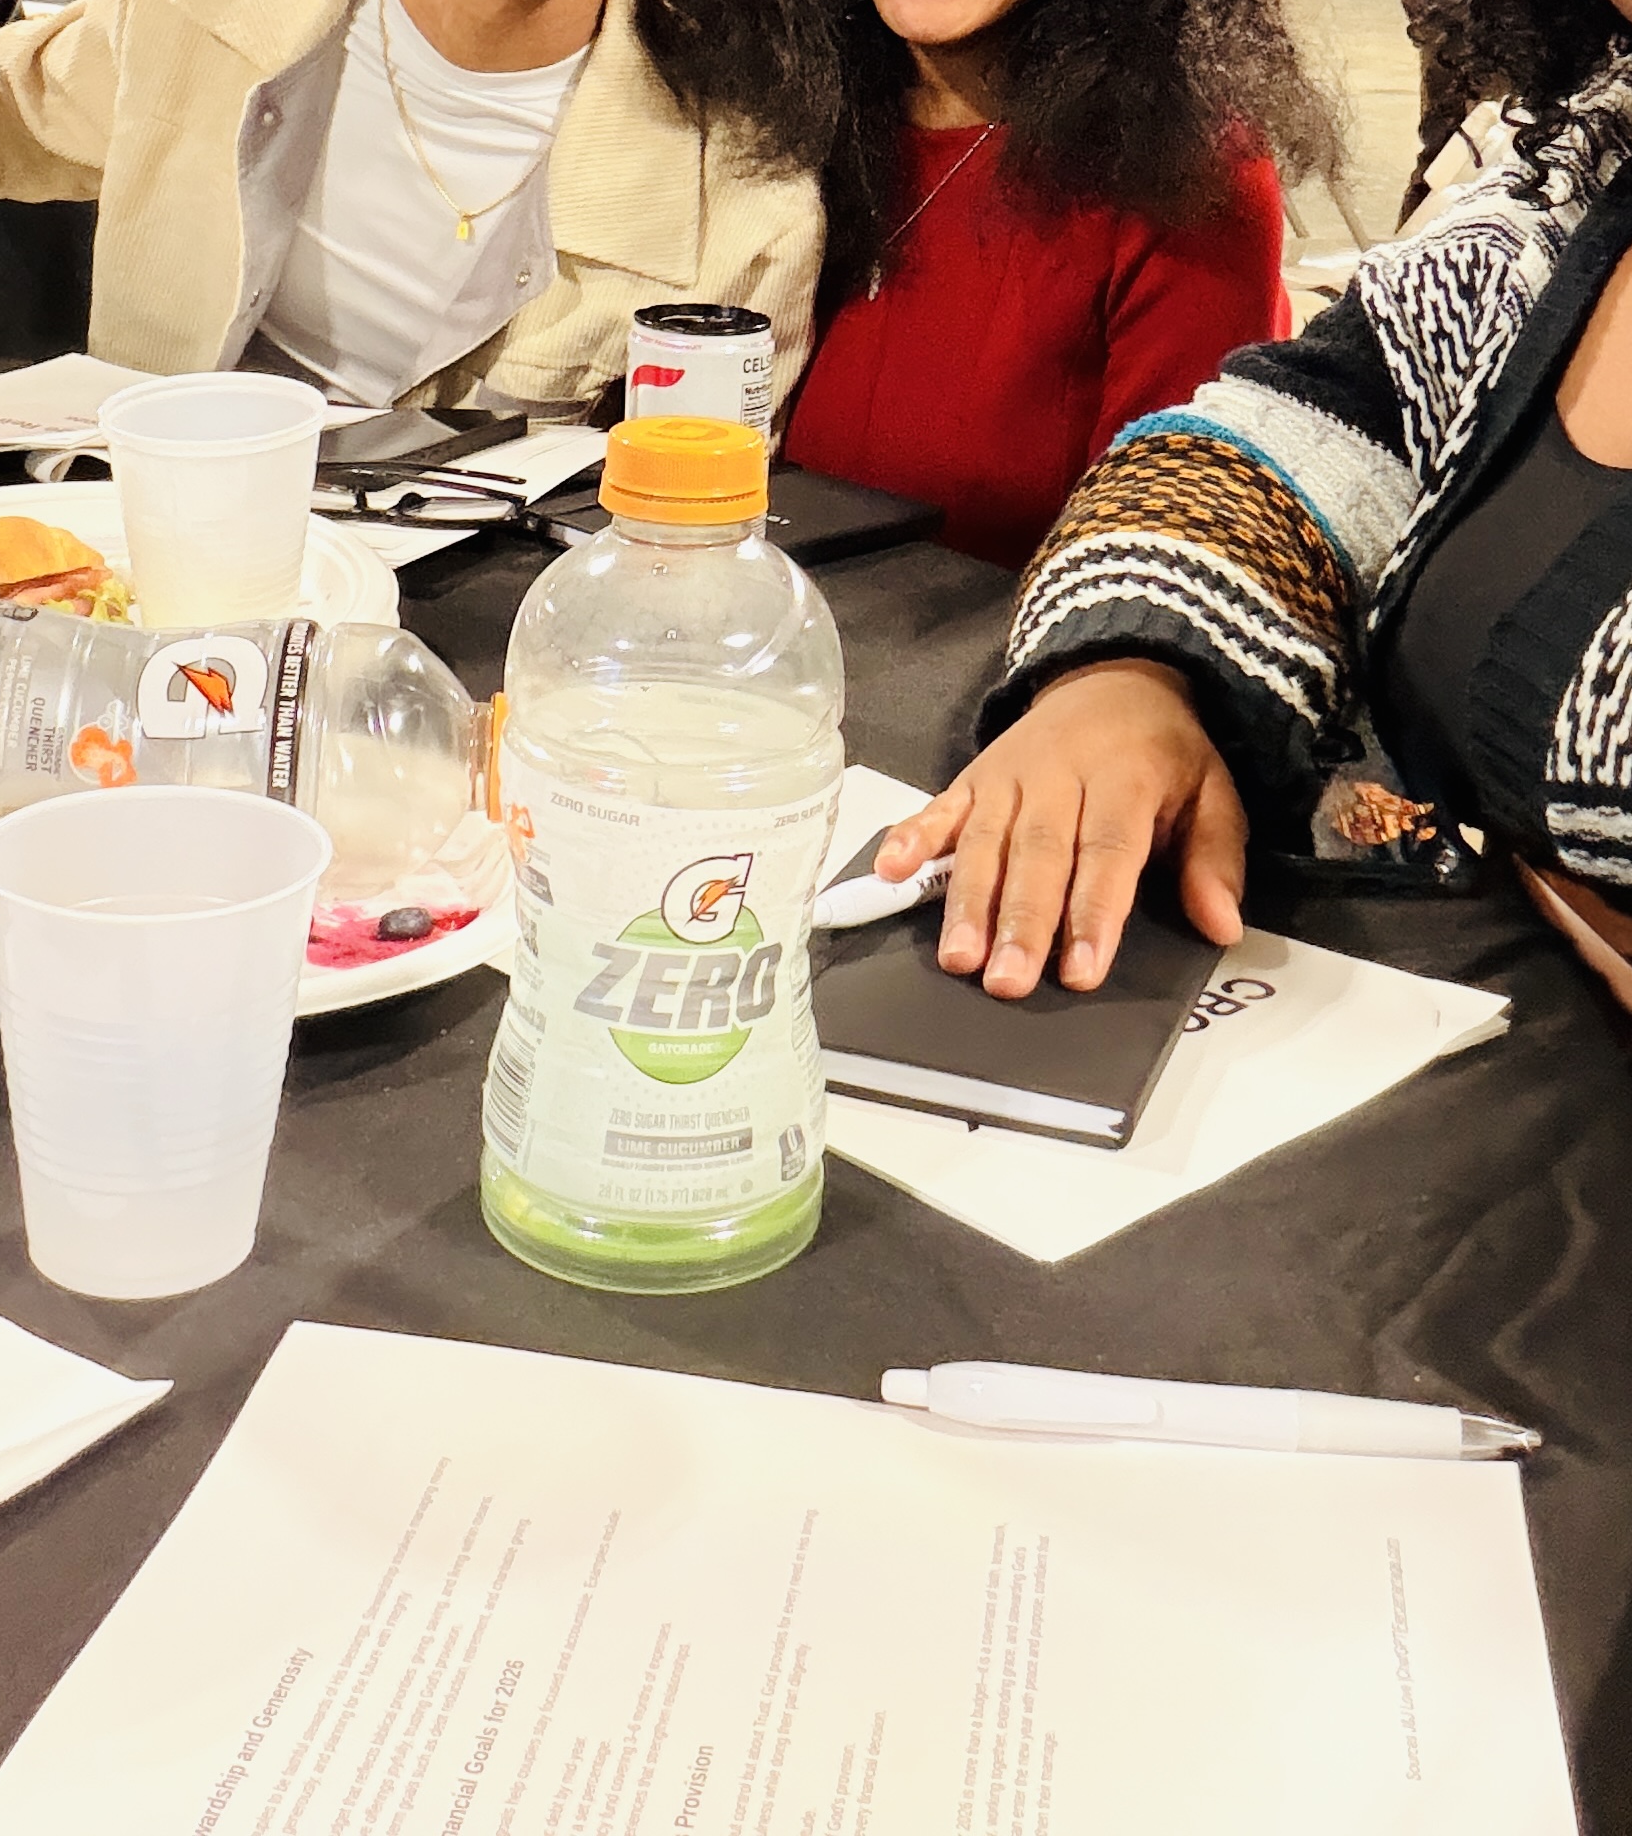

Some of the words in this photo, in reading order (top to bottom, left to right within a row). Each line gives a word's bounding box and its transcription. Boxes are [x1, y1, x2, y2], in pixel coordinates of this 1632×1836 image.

[279, 655, 303, 697] BETTER
[26, 698, 45, 772] QUENCHER
[275, 699, 296, 737] THAN
[40, 726, 56, 774] THIRST
[272, 740, 292, 788] WATER
[550, 791, 584, 814] ZERO
[586, 803, 641, 827] SUGAR
[773, 811, 800, 828] ZERO
[573, 941, 783, 1031] ZERO
[647, 1040, 716, 1055] GATORADE
[608, 1107, 633, 1127] ZERO
[633, 1112, 666, 1130] SUGAR
[669, 1112, 703, 1131] THIRST
[704, 1106, 751, 1131] QUENCHER
[617, 1136, 652, 1155] LIME
[656, 1135, 741, 1157] CUCUMBER
[494, 1659, 525, 1698] 2026
[237, 1729, 266, 1762] and
[252, 1647, 314, 1729] Generosity
[483, 1698, 510, 1724] for
[464, 1727, 499, 1775] Goals
[674, 1745, 714, 1829] Provision
